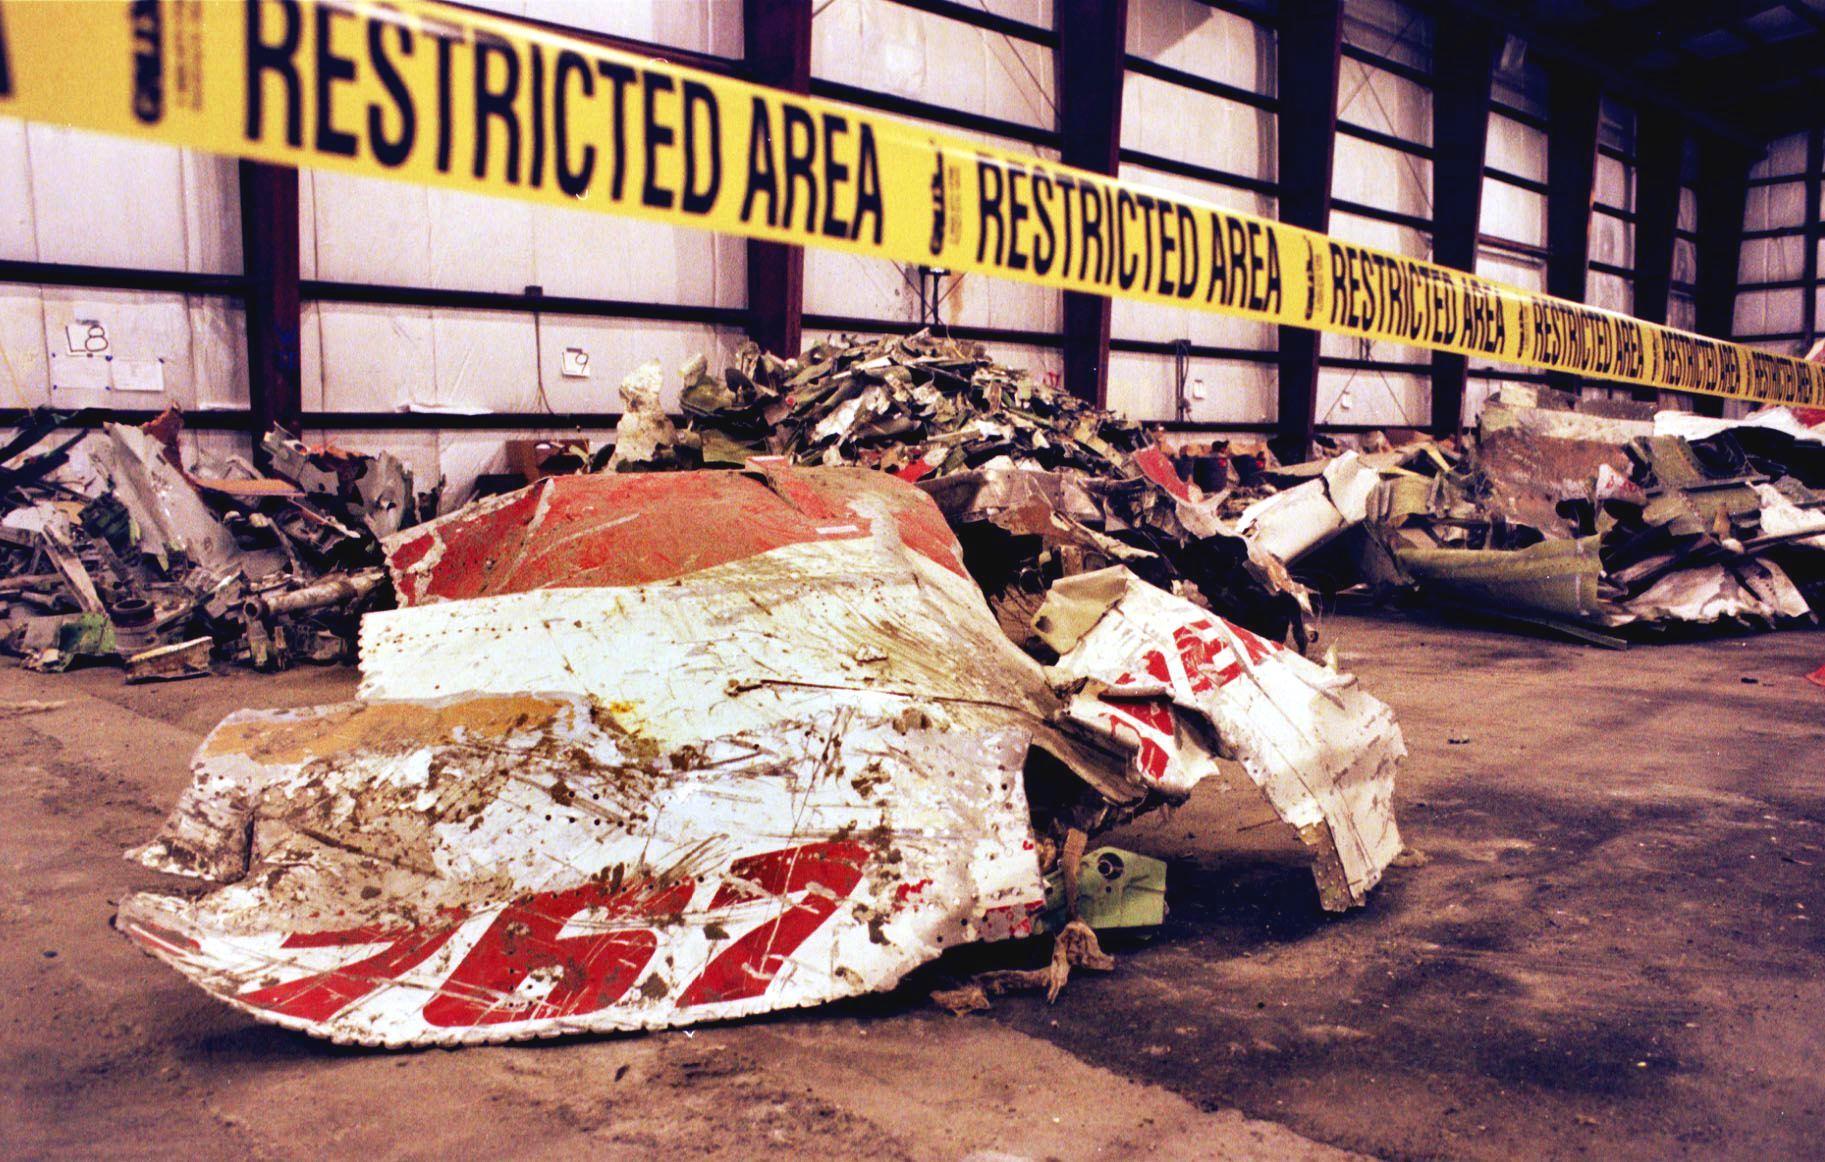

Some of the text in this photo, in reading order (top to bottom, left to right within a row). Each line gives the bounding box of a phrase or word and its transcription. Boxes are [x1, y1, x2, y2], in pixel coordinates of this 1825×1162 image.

[244, 0, 721, 216] RESTRICTED
[740, 97, 886, 246] AREA
[976, 151, 1200, 300] RESTRICTED
[1207, 212, 1282, 315] AREA
[1329, 241, 1457, 345] RESTRICTED
[1460, 276, 1506, 354] AREA
[1532, 302, 1613, 374] RESTRICTED
[1613, 315, 1644, 379] AREA
[1660, 330, 1719, 391] RESTRICTED
[1718, 343, 1741, 394] AREA
